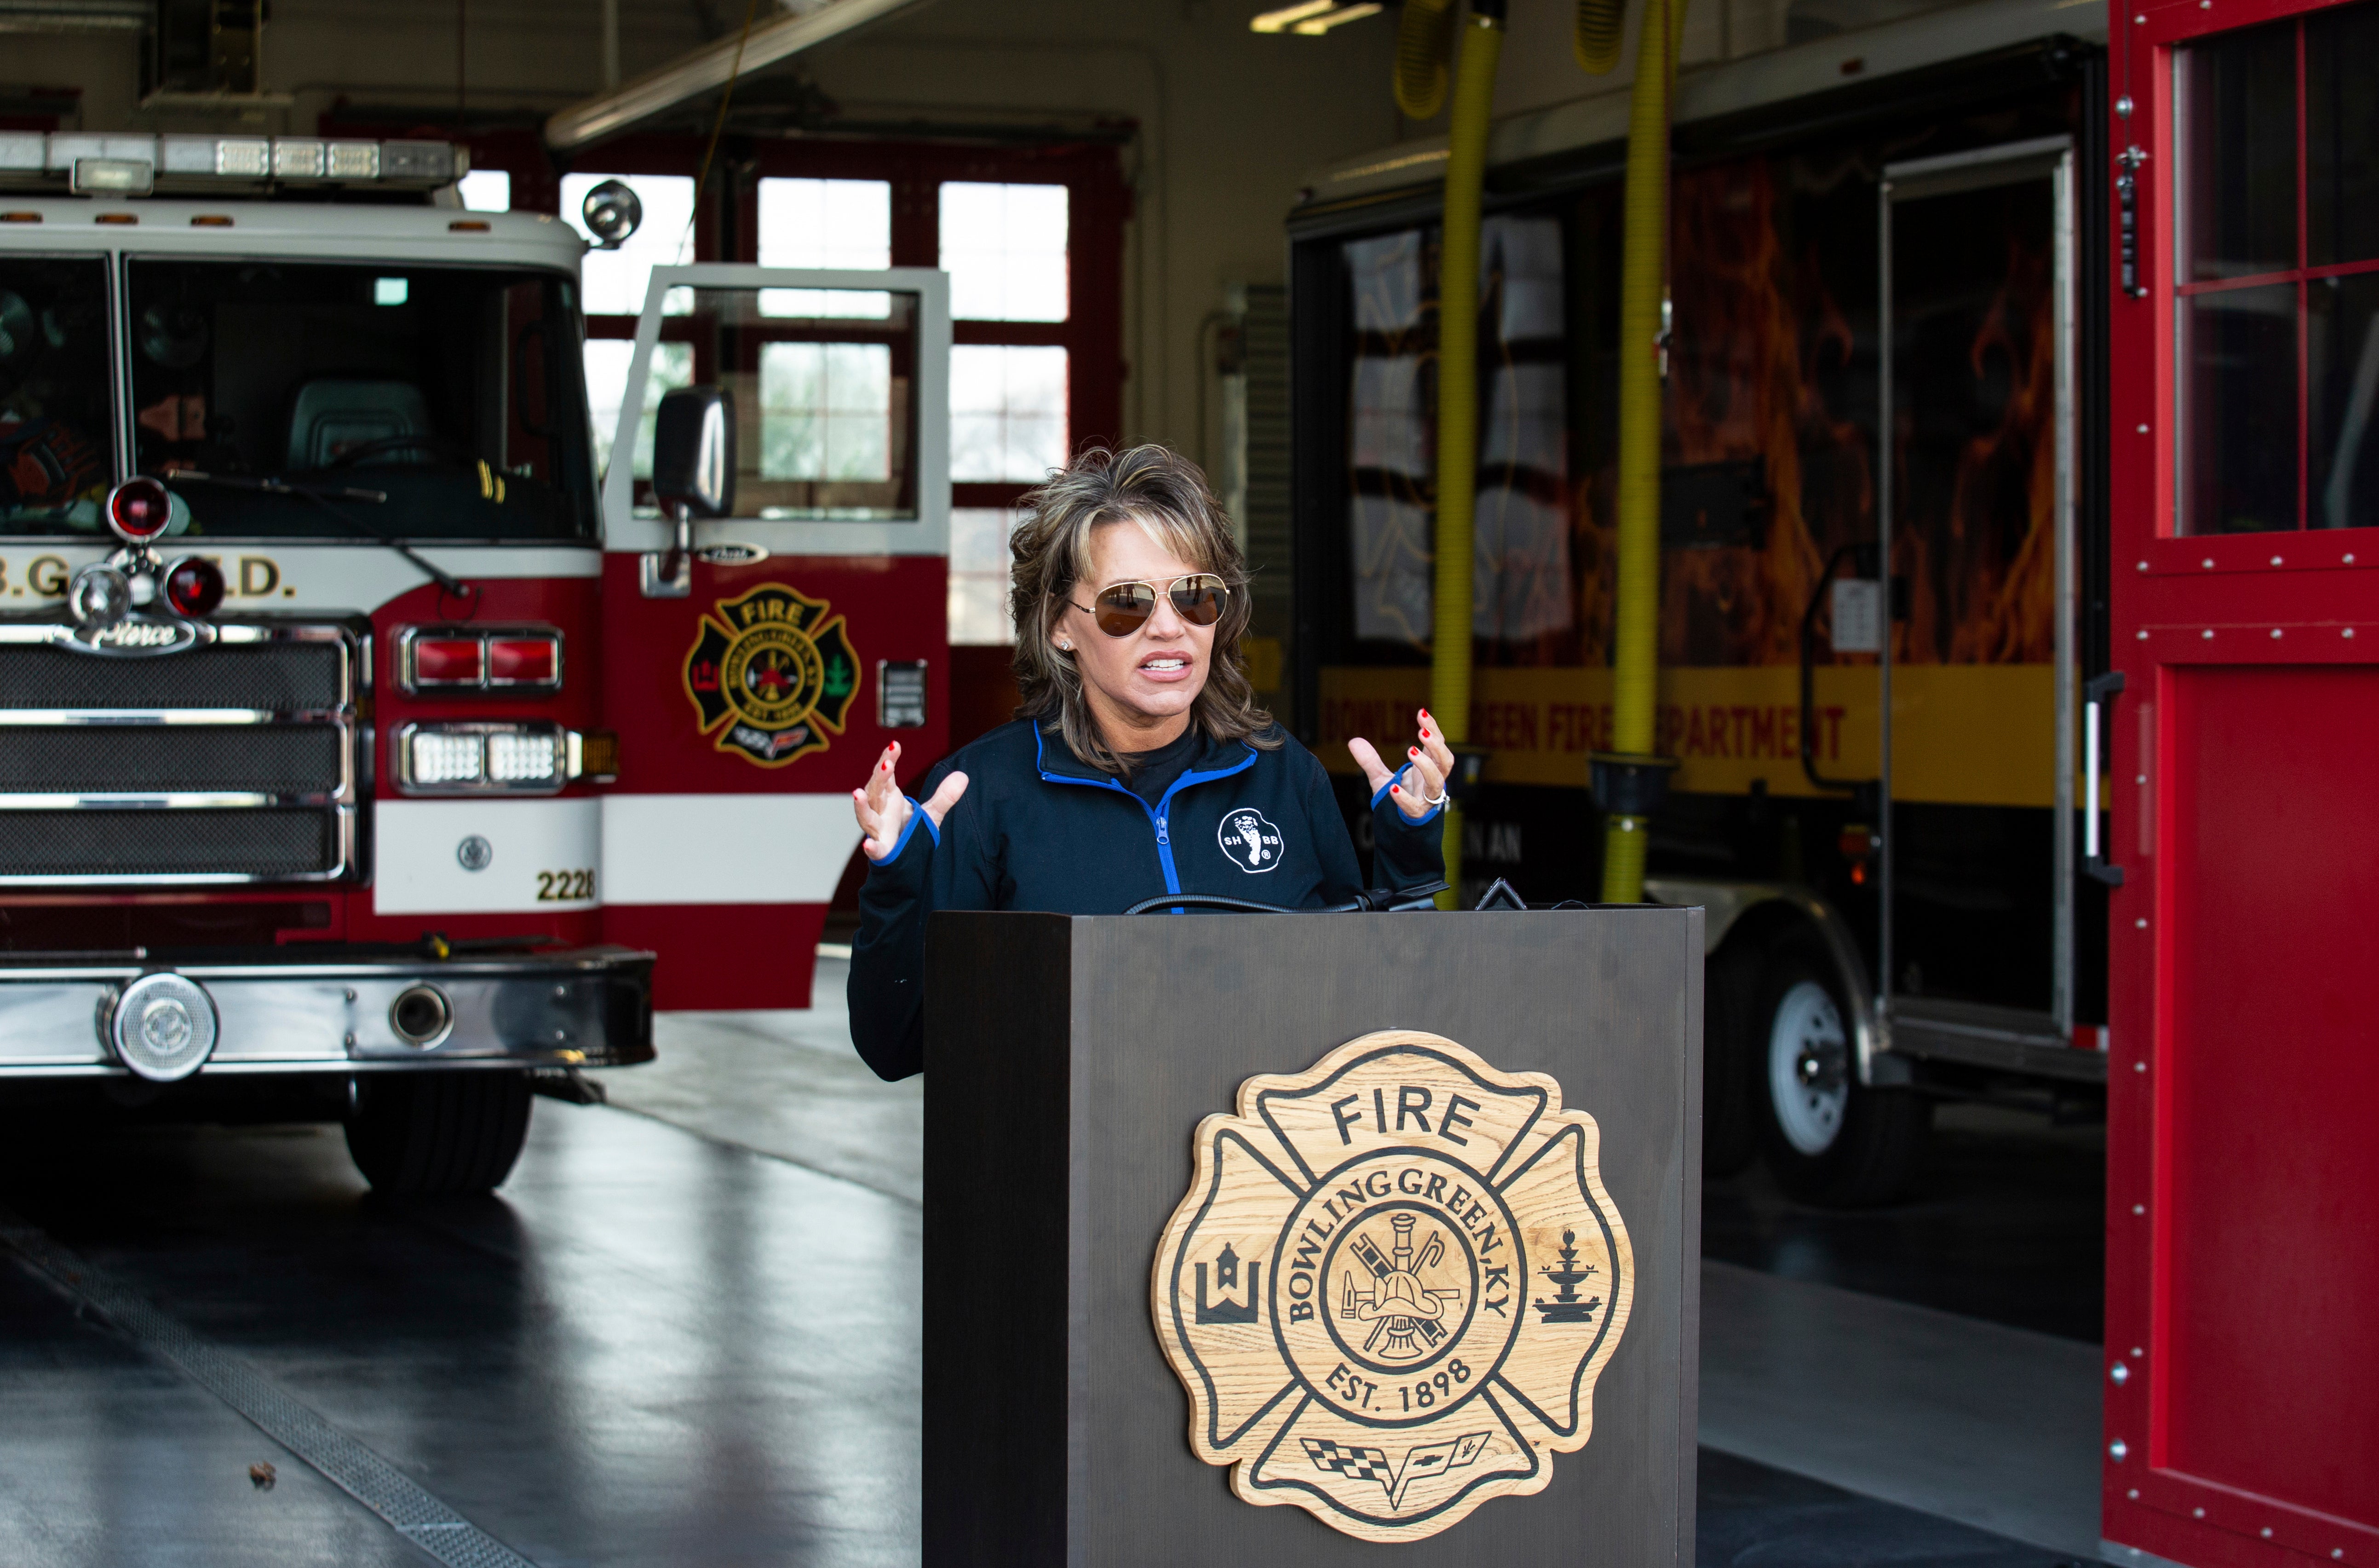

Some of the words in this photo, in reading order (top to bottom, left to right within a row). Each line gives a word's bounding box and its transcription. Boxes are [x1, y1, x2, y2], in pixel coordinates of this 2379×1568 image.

[740, 598, 805, 626] FIRE
[1224, 836, 1241, 845] SH
[1262, 836, 1279, 844] BB
[1331, 1086, 1481, 1147] FIRE
[1289, 1170, 1392, 1325] BOWLING
[1484, 1264, 1510, 1318] KY
[1325, 1362, 1381, 1412] EST.
[1398, 1358, 1471, 1412] 1898
